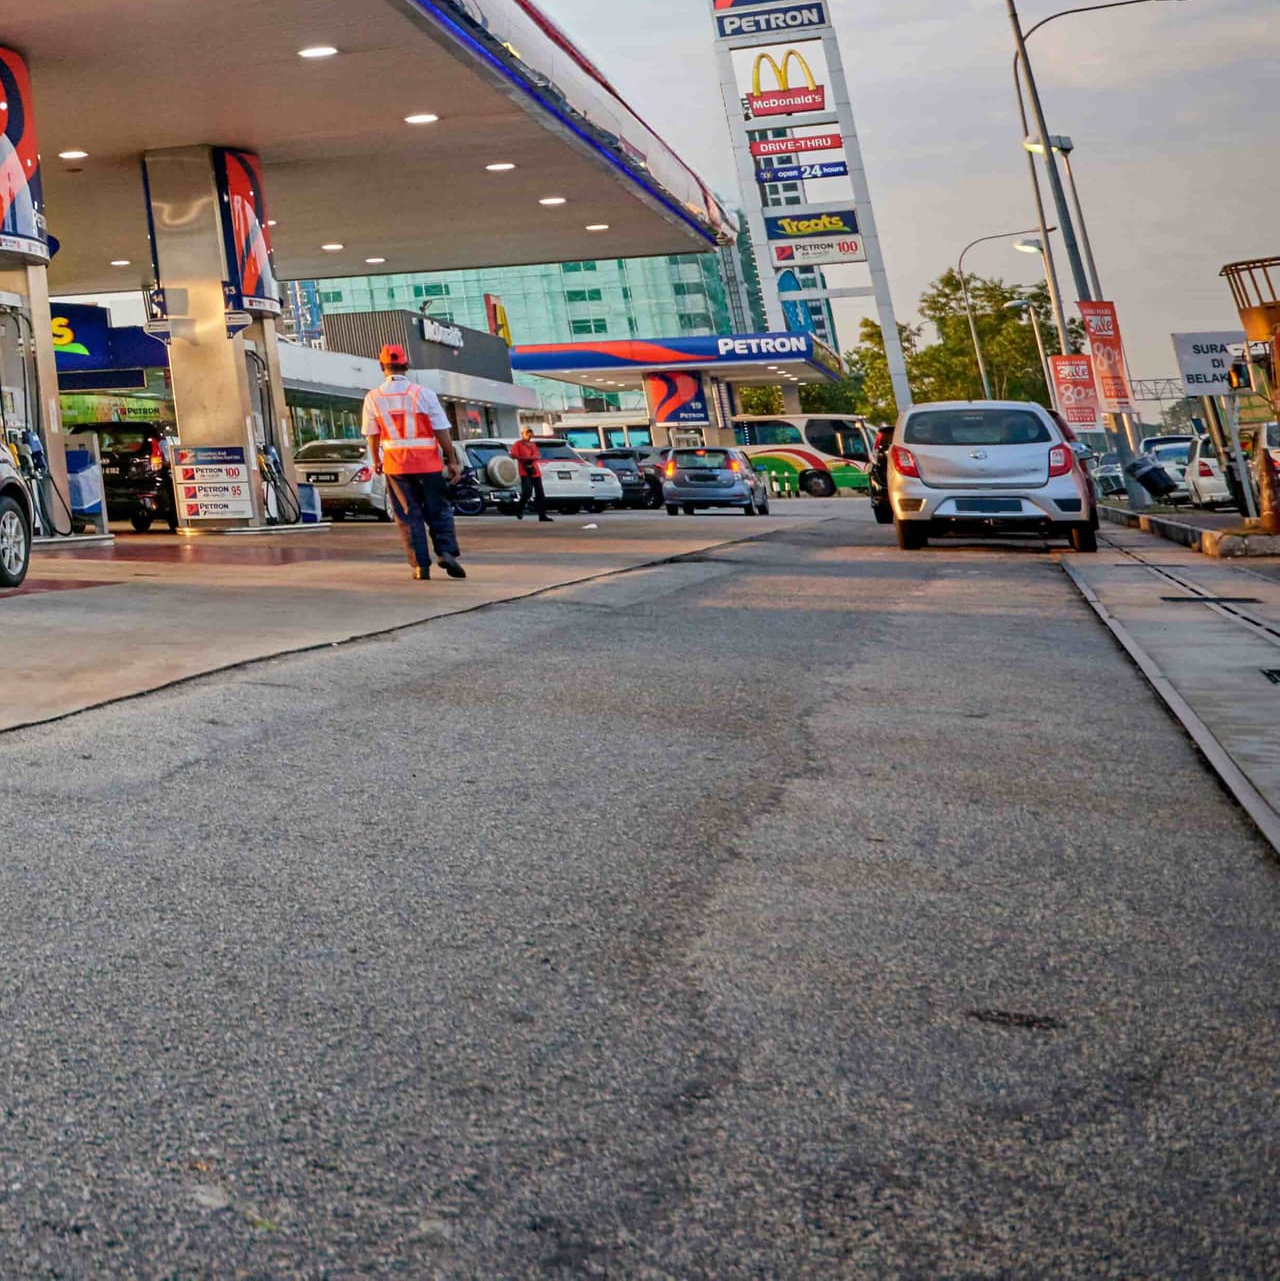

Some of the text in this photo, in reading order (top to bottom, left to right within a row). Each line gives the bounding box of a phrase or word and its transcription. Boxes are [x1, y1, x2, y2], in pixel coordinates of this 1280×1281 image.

[722, 8, 820, 35] PETRON
[752, 93, 823, 110] McDonald's
[760, 137, 832, 152] DRIVE-THRU
[777, 164, 845, 179] open 24 hours
[795, 240, 858, 253] PETRON 100
[224, 286, 237, 295] 13
[718, 336, 808, 355] PETRON
[1192, 344, 1230, 355] SURA
[1212, 359, 1225, 369] DI
[1186, 373, 1230, 384] BELAK
[127, 406, 160, 416] PETRON
[224, 467, 240, 478] 100
[197, 485, 230, 493] PETRON
[231, 486, 242, 496] 95
